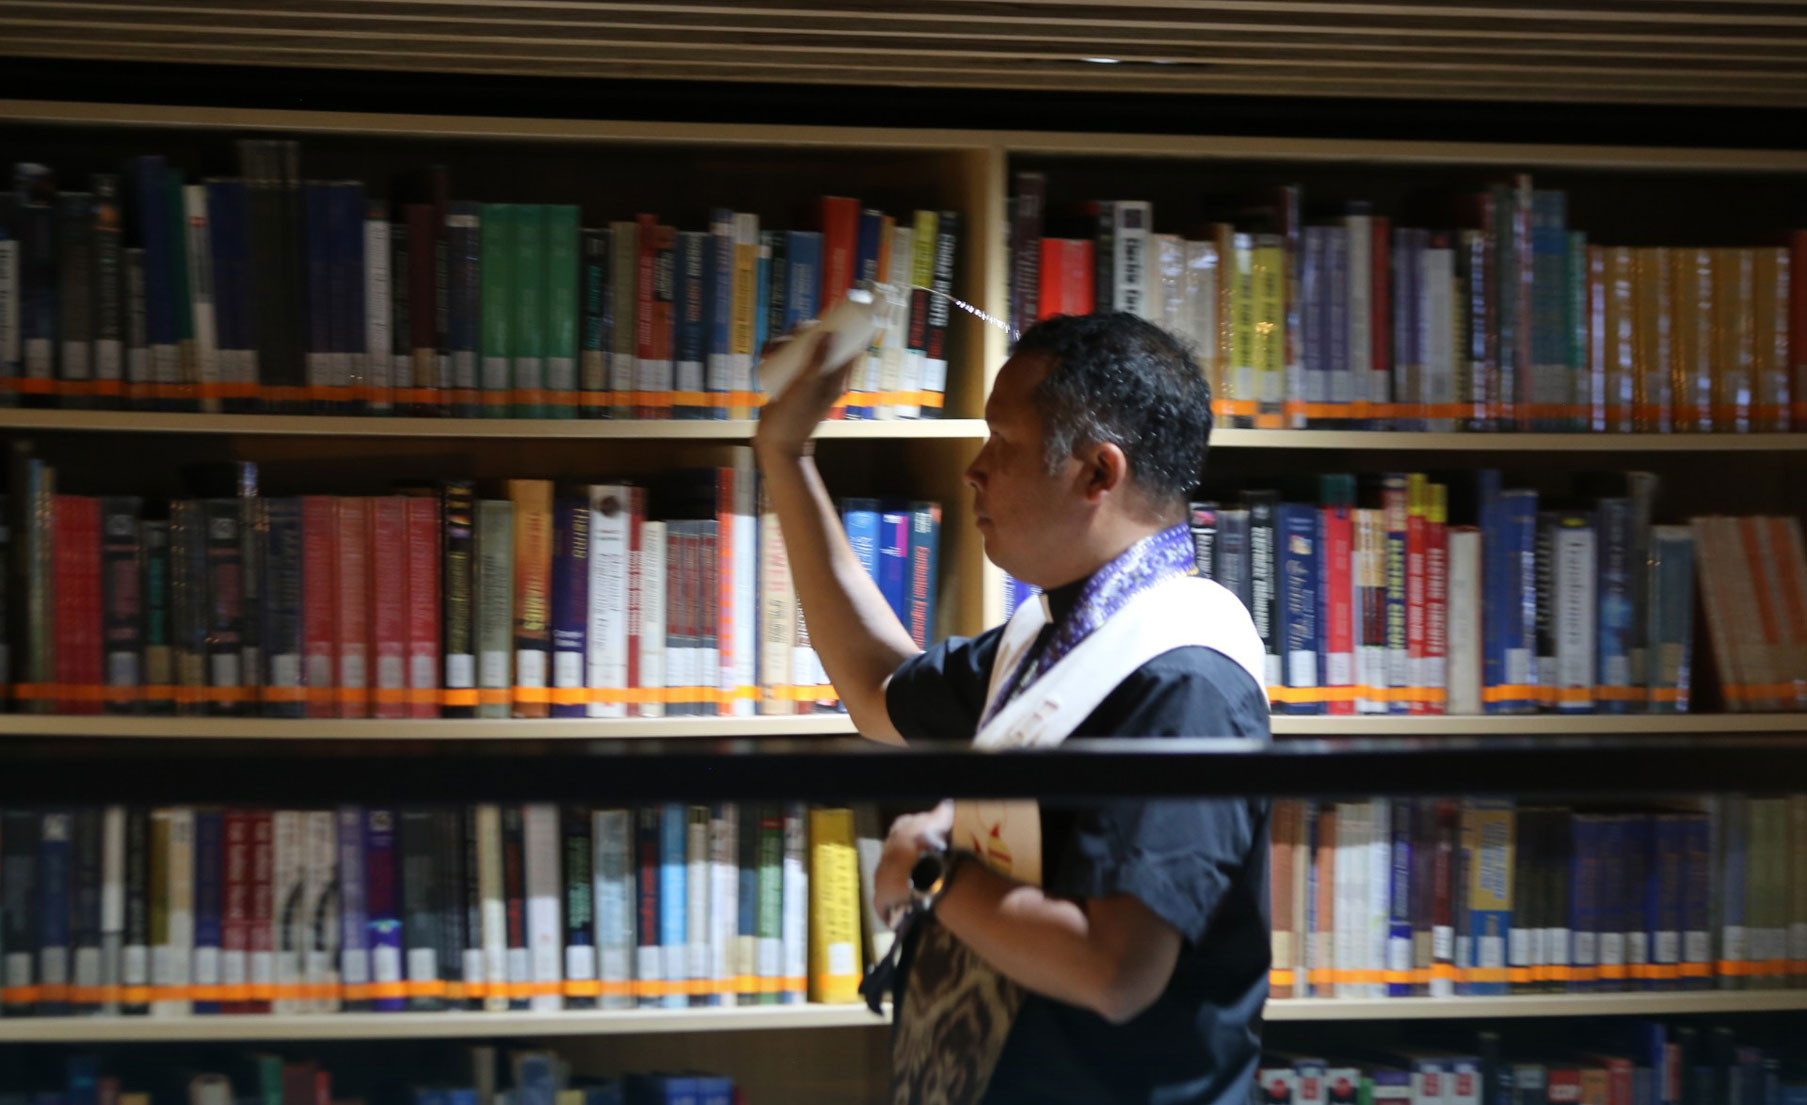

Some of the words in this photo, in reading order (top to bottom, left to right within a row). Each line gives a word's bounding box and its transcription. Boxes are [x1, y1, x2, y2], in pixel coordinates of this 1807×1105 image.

[1426, 548, 1445, 600] ELECTRIC
[1387, 603, 1405, 649] CIRCUI
[1426, 603, 1444, 653] CIRCUITS
